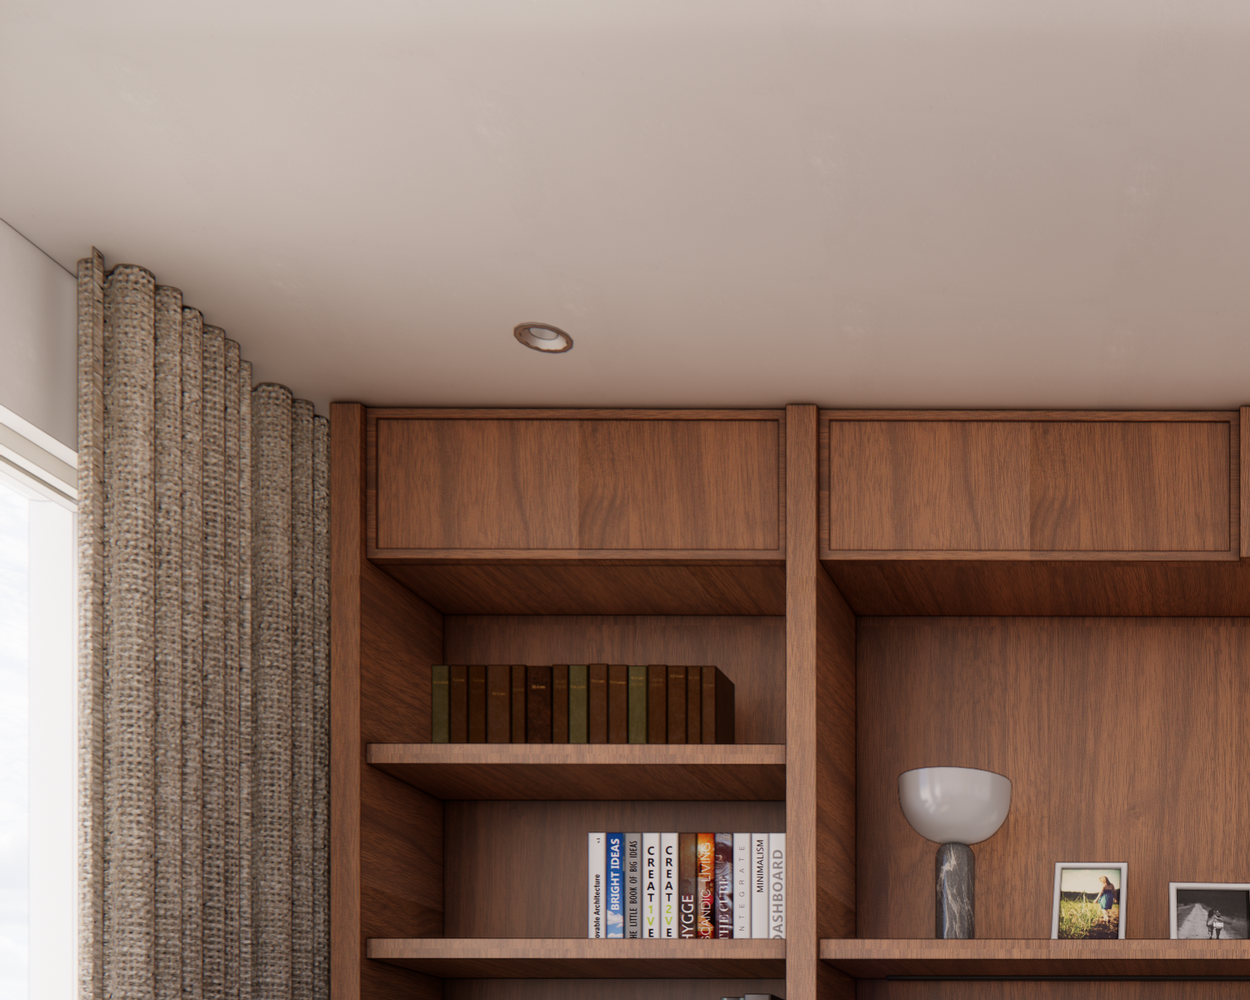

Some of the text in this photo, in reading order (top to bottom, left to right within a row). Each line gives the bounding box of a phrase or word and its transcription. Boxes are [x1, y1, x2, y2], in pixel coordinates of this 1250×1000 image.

[611, 838, 620, 910] BRIGHT IDEAS
[629, 841, 638, 858] IDEAS
[629, 861, 638, 872] BIG
[629, 887, 638, 904] BOOK
[629, 908, 638, 926] LITTLE
[647, 846, 655, 937] CREAT1VE
[665, 846, 673, 937] CREAT2VE
[682, 895, 694, 939] HYGGE
[700, 842, 711, 939] SCANDIC LIVING
[718, 876, 729, 939] THE CUBE
